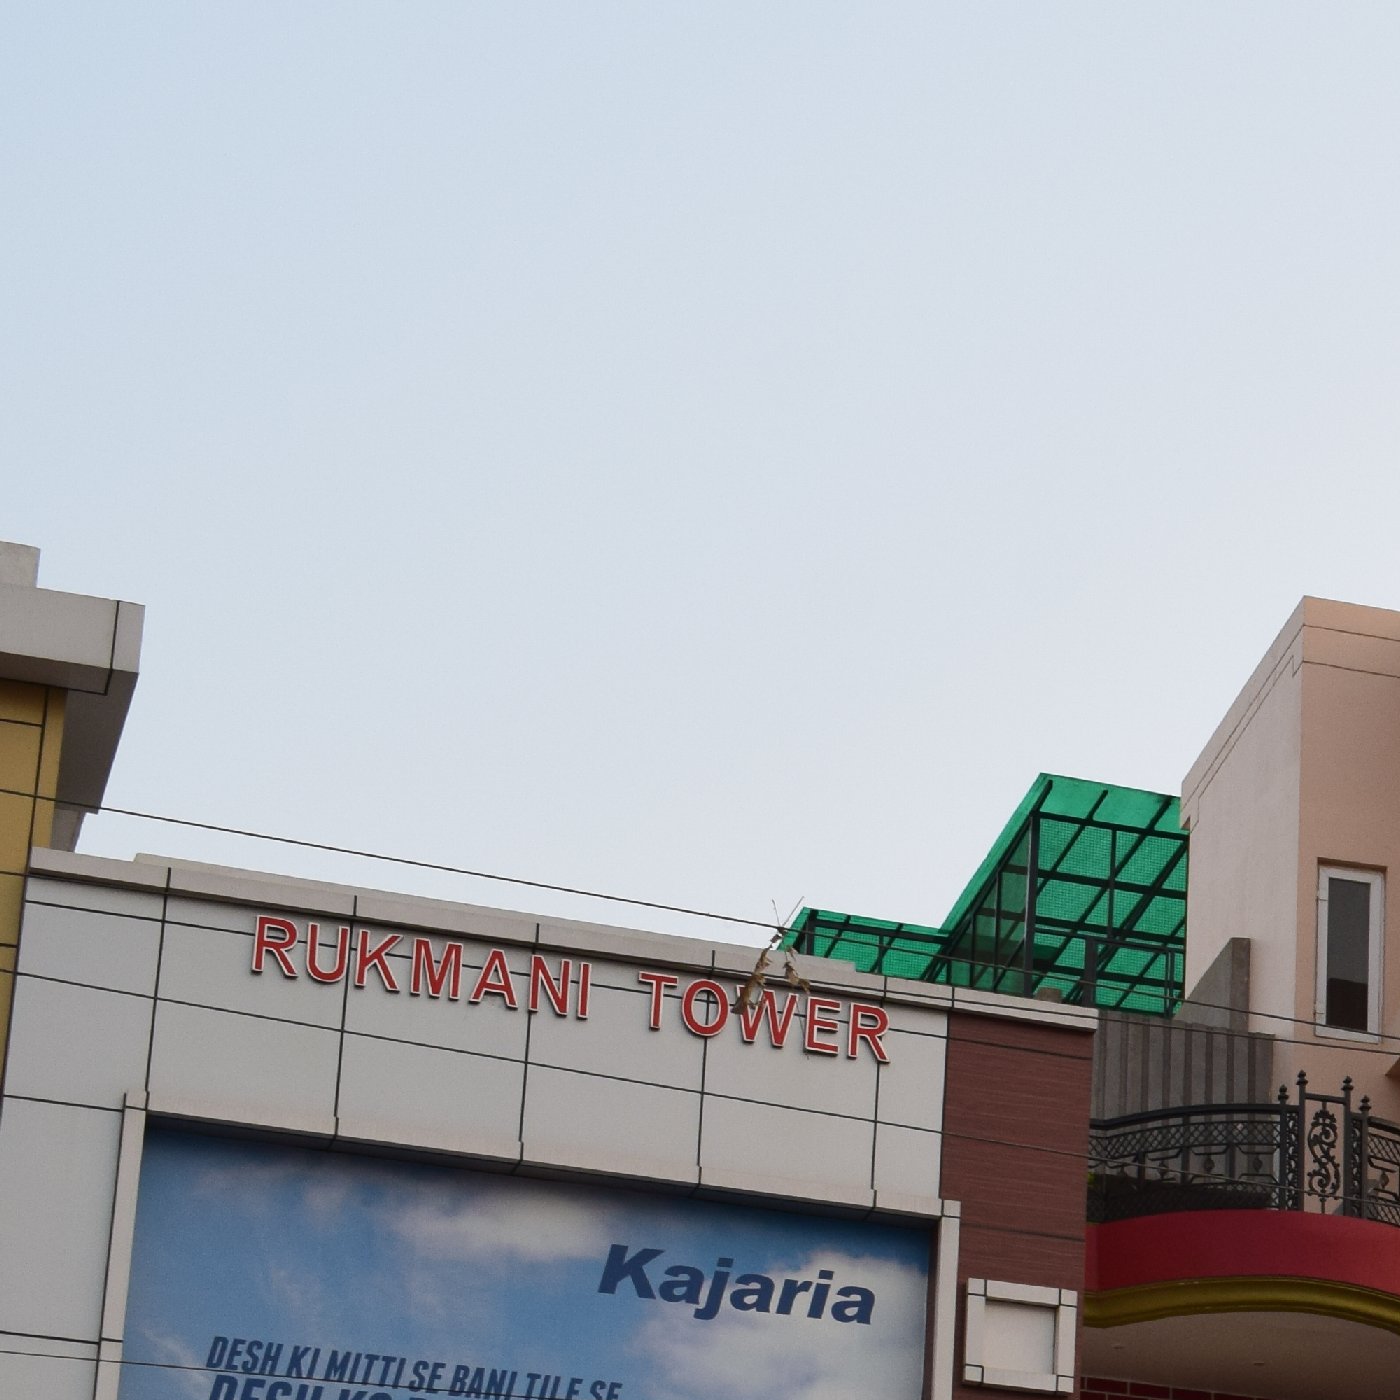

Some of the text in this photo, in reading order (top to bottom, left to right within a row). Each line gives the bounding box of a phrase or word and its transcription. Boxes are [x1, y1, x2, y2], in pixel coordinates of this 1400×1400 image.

[250, 914, 891, 1064] RUKMANI TOWER
[598, 1243, 875, 1326] Kajaria
[206, 1335, 280, 1374] DESH
[289, 1346, 321, 1378] KI
[323, 1349, 405, 1387] MITTI
[411, 1360, 447, 1392] SE
[450, 1364, 517, 1400] BANI
